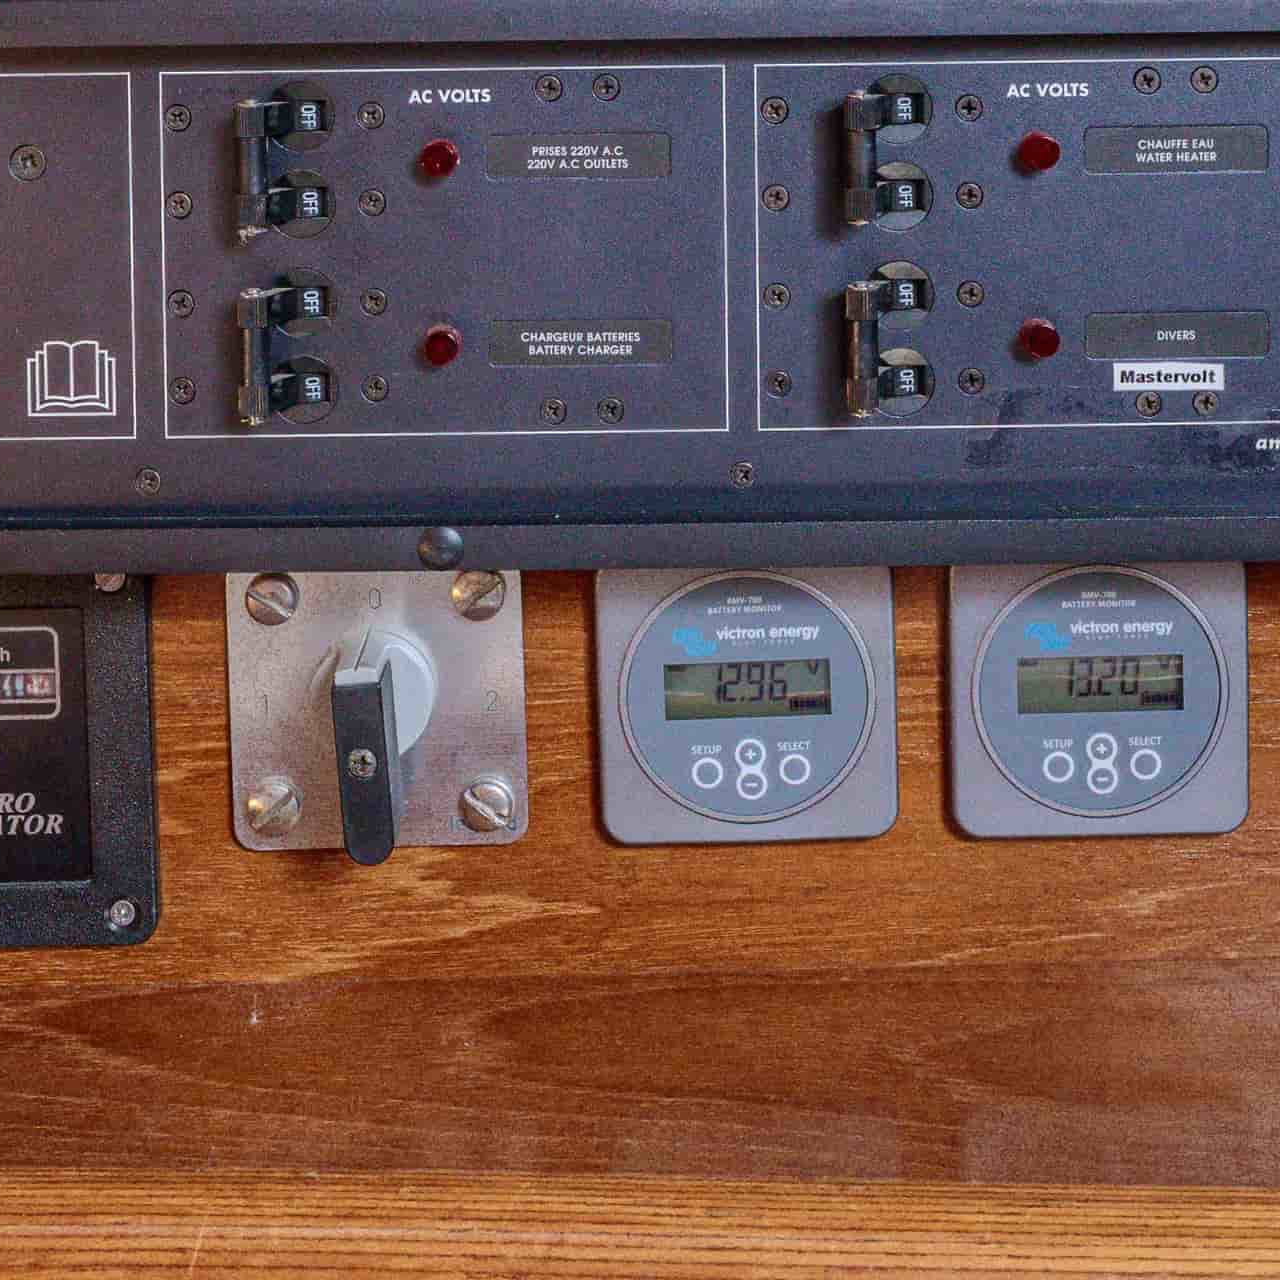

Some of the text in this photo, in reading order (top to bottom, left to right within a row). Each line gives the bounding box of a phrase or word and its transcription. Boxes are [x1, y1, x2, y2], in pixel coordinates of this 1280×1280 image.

[1007, 83, 1088, 97] AC VOLTS
[409, 88, 491, 104] AC VOLTS
[1138, 139, 1214, 150] CHAUFFE EAU
[532, 146, 623, 157] PRISES 220V A.C
[1136, 152, 1217, 163] WATER HEATER
[527, 158, 628, 169] 220V A.C OUTLETS
[521, 332, 641, 343] CHARGEUR BATTERIES
[1157, 330, 1196, 341] DIVERS
[529, 345, 633, 355] BATTERY CHARGER
[1120, 369, 1216, 385] Mastervolt
[717, 626, 819, 640] victron energy
[1070, 621, 1173, 635] victron energy
[0, 647, 10, 662] h
[777, 742, 811, 752] SELECT
[1042, 739, 1073, 749] SETUP
[1129, 737, 1162, 746] SELECT
[691, 744, 722, 754] SETUP
